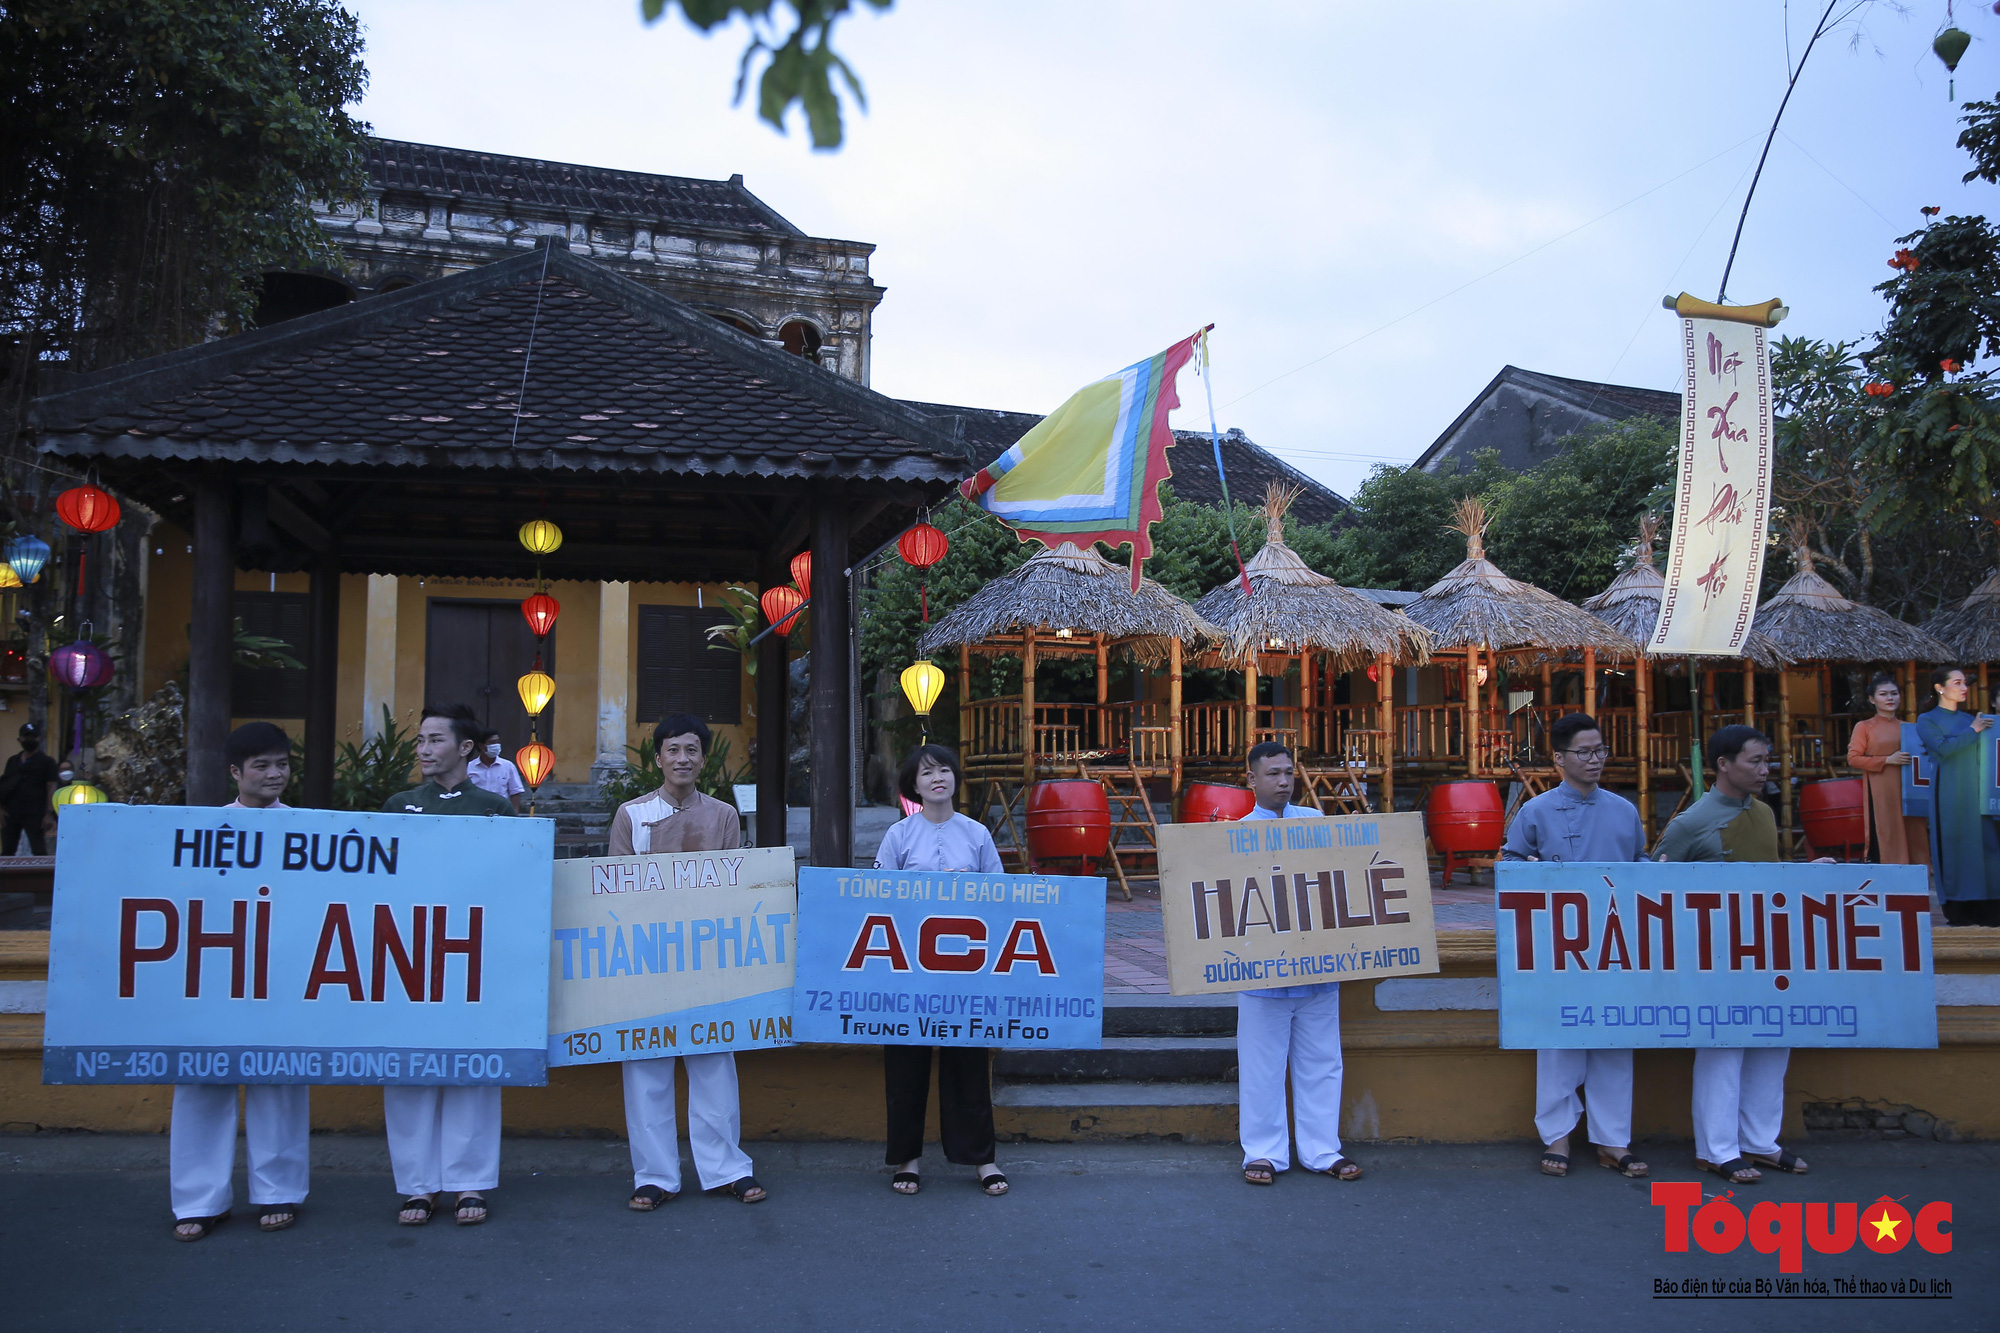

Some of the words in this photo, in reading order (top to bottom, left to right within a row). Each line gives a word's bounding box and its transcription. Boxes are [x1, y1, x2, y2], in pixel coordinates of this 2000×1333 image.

[172, 823, 263, 877] HIỆU
[282, 828, 399, 875] BUÔN
[1226, 824, 1260, 856] TIỆM
[1335, 816, 1380, 847] THÁNH
[592, 858, 666, 895] NHÀ
[672, 856, 745, 890] MAY
[896, 877, 931, 903] ĐẠI
[554, 910, 685, 981] THÀNH
[691, 900, 791, 971] PHÁT
[1498, 874, 1677, 973] TRẦN
[1799, 878, 1931, 973] NẾT
[303, 902, 484, 1003] ANH
[840, 912, 1060, 977] ACA
[805, 990, 833, 1012] 72
[838, 990, 910, 1014] ĐUONG
[913, 992, 998, 1017] NGUYEN
[1054, 997, 1096, 1018] HOC
[1560, 1005, 1596, 1028] 54
[563, 1032, 602, 1057] 130
[616, 1025, 677, 1051] TRAN
[690, 1020, 735, 1046] CAO
[749, 1015, 793, 1041] VAN
[239, 1052, 322, 1078] QUANG
[328, 1053, 401, 1078] ĐONG
[409, 1054, 448, 1078] FAI
